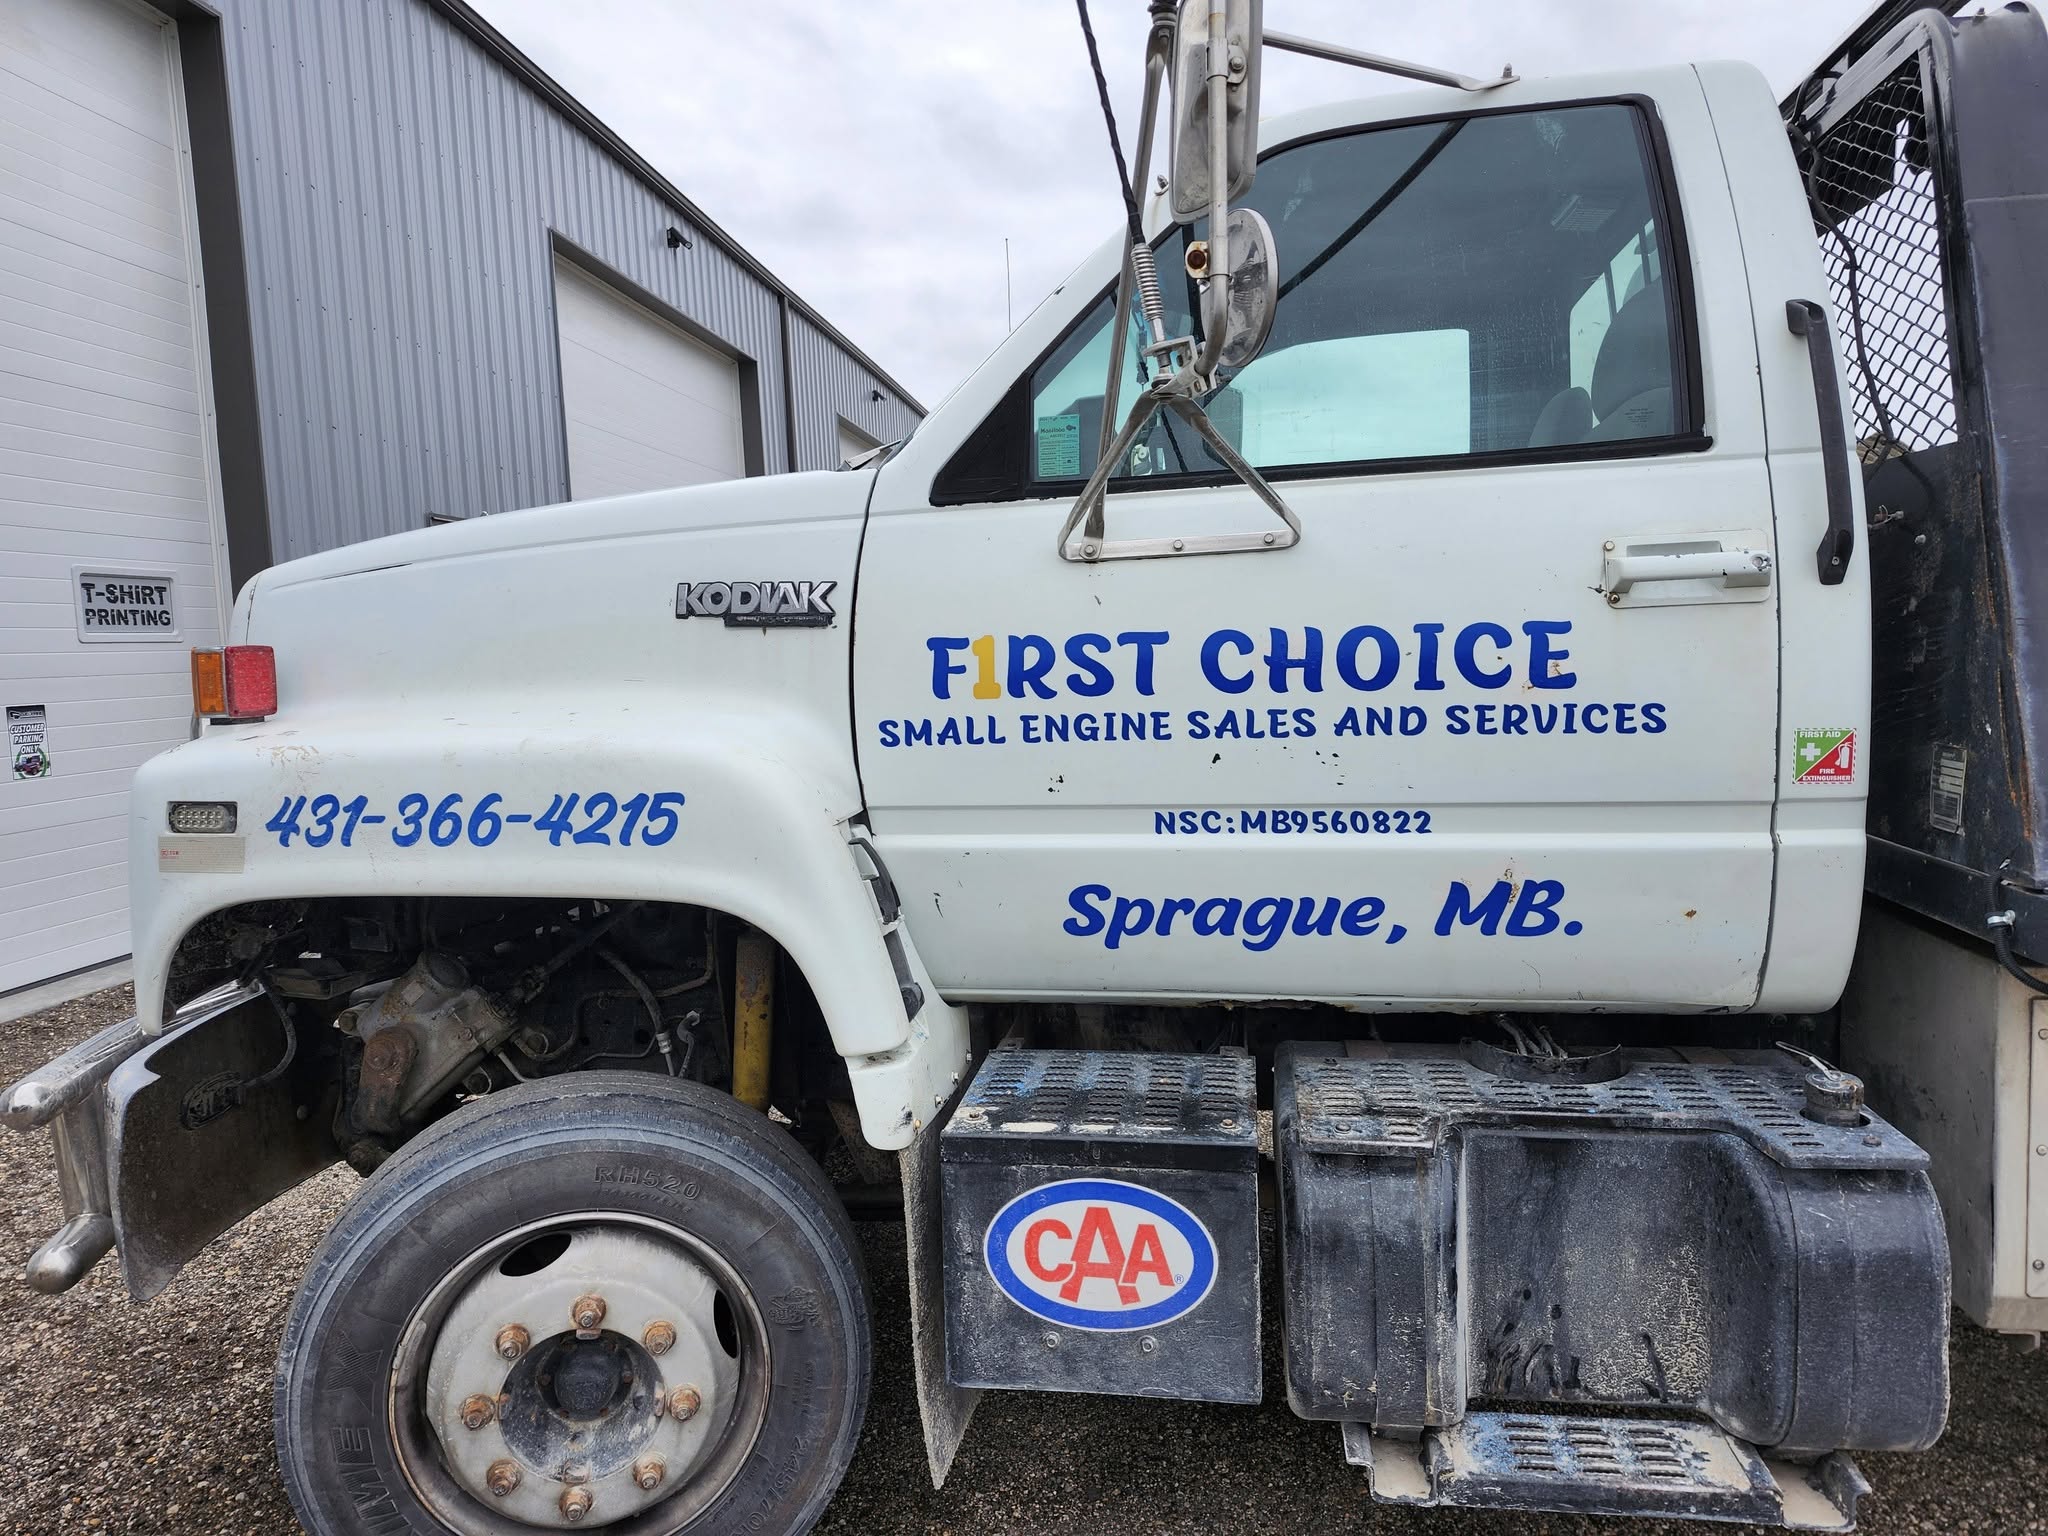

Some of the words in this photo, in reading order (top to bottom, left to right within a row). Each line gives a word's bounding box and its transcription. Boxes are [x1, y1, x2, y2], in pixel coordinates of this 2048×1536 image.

[81, 582, 168, 606] T-SHIRT
[676, 581, 838, 617] KODIAK
[85, 608, 172, 627] PRINTING
[926, 631, 1170, 701] F1RST
[1200, 619, 1578, 694] CHOICE
[10, 723, 45, 734] CUSTOMER
[13, 733, 44, 745] PARKING
[878, 714, 1008, 749] SMALL
[1019, 710, 1173, 745] ENGINE
[1187, 706, 1317, 740] SALES
[1334, 704, 1428, 737] AND
[1445, 702, 1667, 736] SERVICES
[21, 744, 40, 754] ONLY
[265, 791, 686, 849] 431-366-4215
[1153, 810, 1432, 836] NSC:MB9560822
[1062, 883, 1408, 953] Sprague,
[1434, 879, 1584, 938] MB.
[594, 1164, 701, 1200] RH520
[1024, 1206, 1175, 1306] CAA
